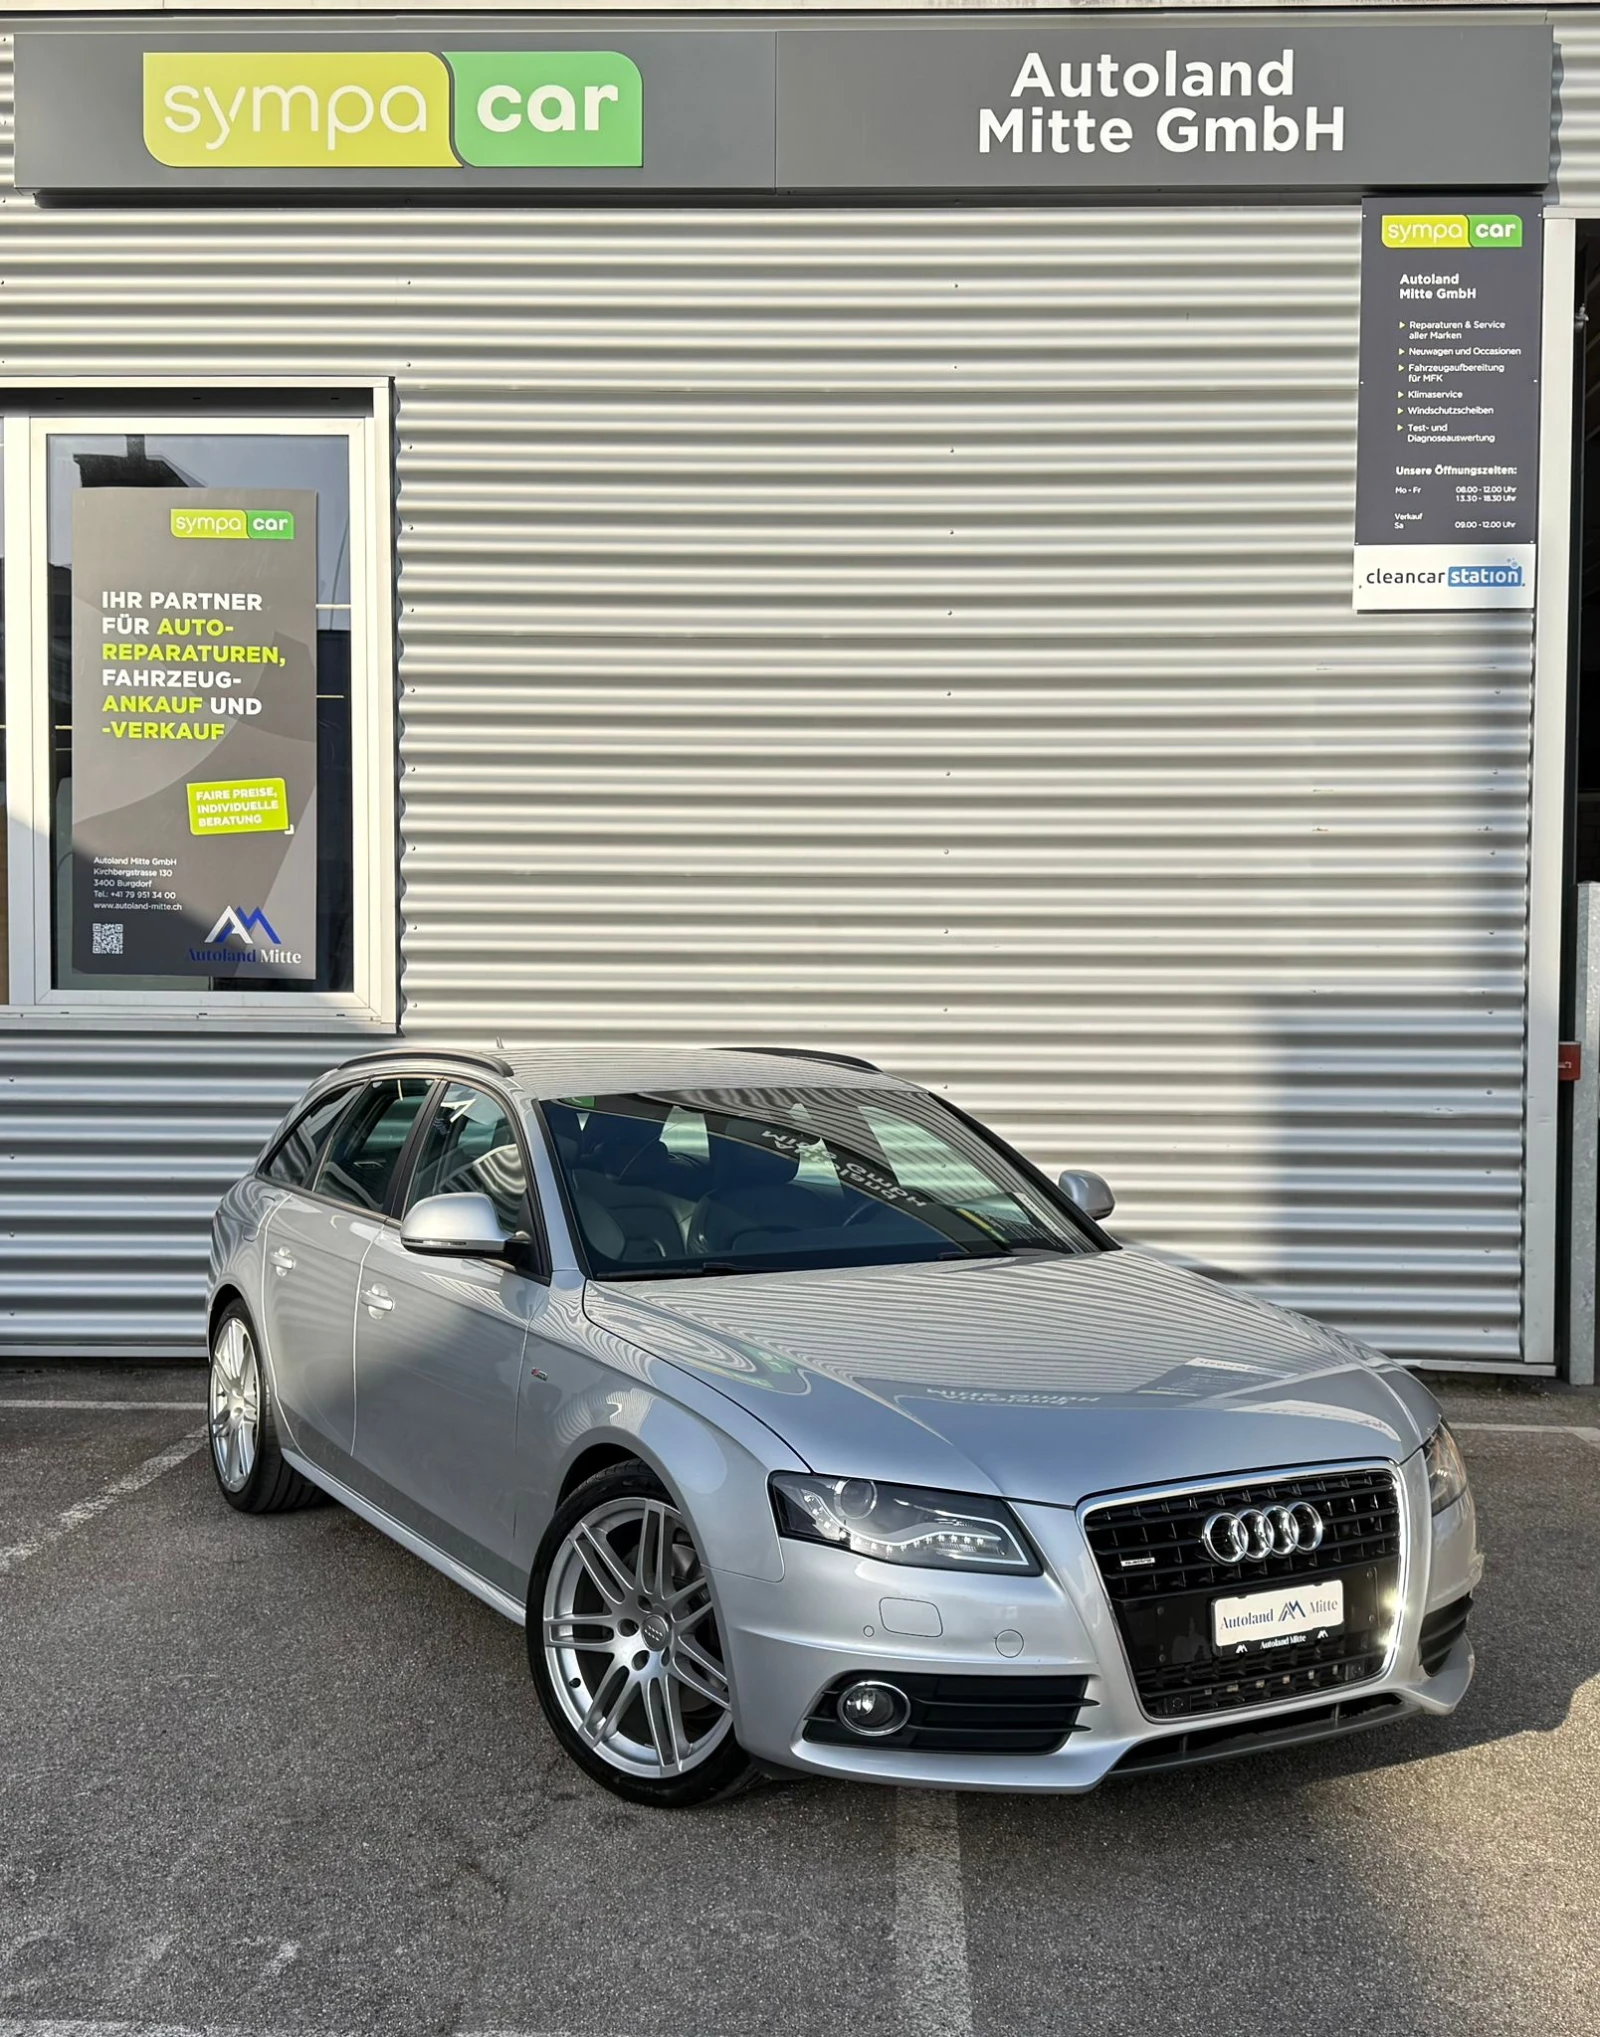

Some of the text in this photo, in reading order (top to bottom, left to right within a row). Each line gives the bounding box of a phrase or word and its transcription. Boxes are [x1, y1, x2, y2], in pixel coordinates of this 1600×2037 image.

[1010, 50, 1295, 99] Autoland
[162, 84, 619, 150] sympa car
[979, 105, 1345, 154] Mitte GmbH
[1387, 222, 1516, 243] sympa car
[1400, 273, 1459, 285] Autoland
[1400, 288, 1477, 299] Mitte GmbH
[1409, 320, 1506, 330] Reparaturen & Service
[1408, 332, 1462, 340] aller Marken
[1408, 347, 1522, 356] Neuwagen und Occasionen
[1408, 364, 1505, 373] Fahrzeugaufbereitung
[1408, 374, 1444, 382] für MFK
[1408, 390, 1463, 398] Klimaservice
[1408, 406, 1494, 415] Windschutzscheiben
[1408, 424, 1448, 432] Test- und
[1408, 434, 1496, 444] Diagnoseauswertung
[1396, 464, 1518, 477] Unsere Öffnungszeiten:
[1395, 486, 1407, 494] Mo
[1413, 486, 1422, 494] Fr
[175, 516, 289, 534] sympa car
[1503, 521, 1516, 529] Uhr
[1366, 568, 1519, 584] cleancar station
[102, 591, 263, 611] IHR PARTNER
[102, 613, 234, 637] FÜR AUTO-
[102, 644, 286, 667] REPARATUREN,
[102, 669, 242, 688] FAHRZEUG-
[102, 695, 263, 715] ANKAUF UND
[102, 721, 225, 741] -VERKAUF
[196, 787, 278, 801] FAIRE PREISE,
[197, 801, 279, 814] INDIVIDUELLE
[198, 815, 262, 827] BERATUNG
[93, 856, 177, 866] Autoland Mitte GmbH
[93, 868, 172, 878] Kirchbergstrasse 130
[93, 879, 153, 889] 3400 Burgdorf
[94, 891, 176, 899] Tel.: +41 79 951 34 00
[93, 902, 183, 911] www.autoland-mitte.ch
[186, 948, 302, 964] Autoland Mitte
[1220, 1608, 1274, 1630] Autoland
[1309, 1599, 1339, 1614] Mitte
[1260, 1638, 1289, 1650] Autoland
